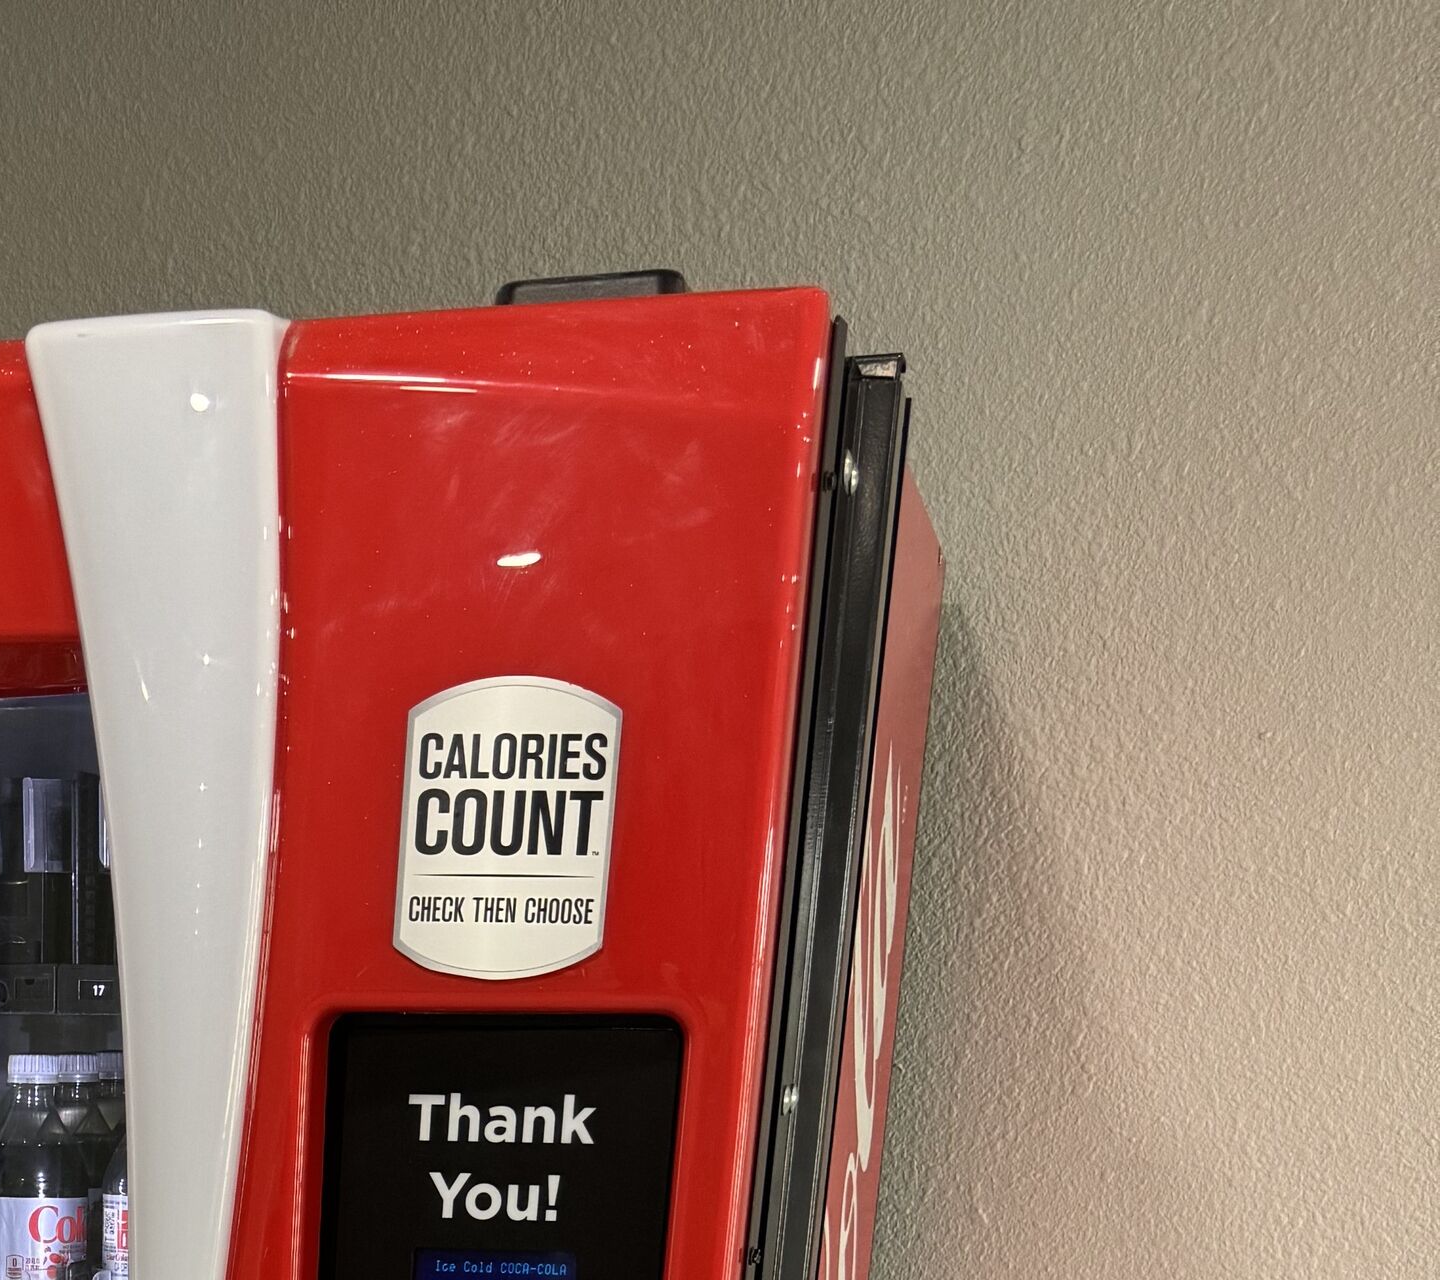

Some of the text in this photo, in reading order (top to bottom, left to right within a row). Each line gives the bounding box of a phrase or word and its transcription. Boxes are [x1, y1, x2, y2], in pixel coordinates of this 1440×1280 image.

[418, 732, 608, 780] CALORIES
[414, 788, 604, 856] COUNT
[408, 896, 595, 925] CHECK THEN CHOOSE
[92, 985, 105, 996] 17
[408, 1092, 597, 1145] Thank
[428, 1171, 561, 1222] You!
[28, 1204, 88, 1244] Cok
[435, 1259, 567, 1276] Ice Cold COCA-COLA
